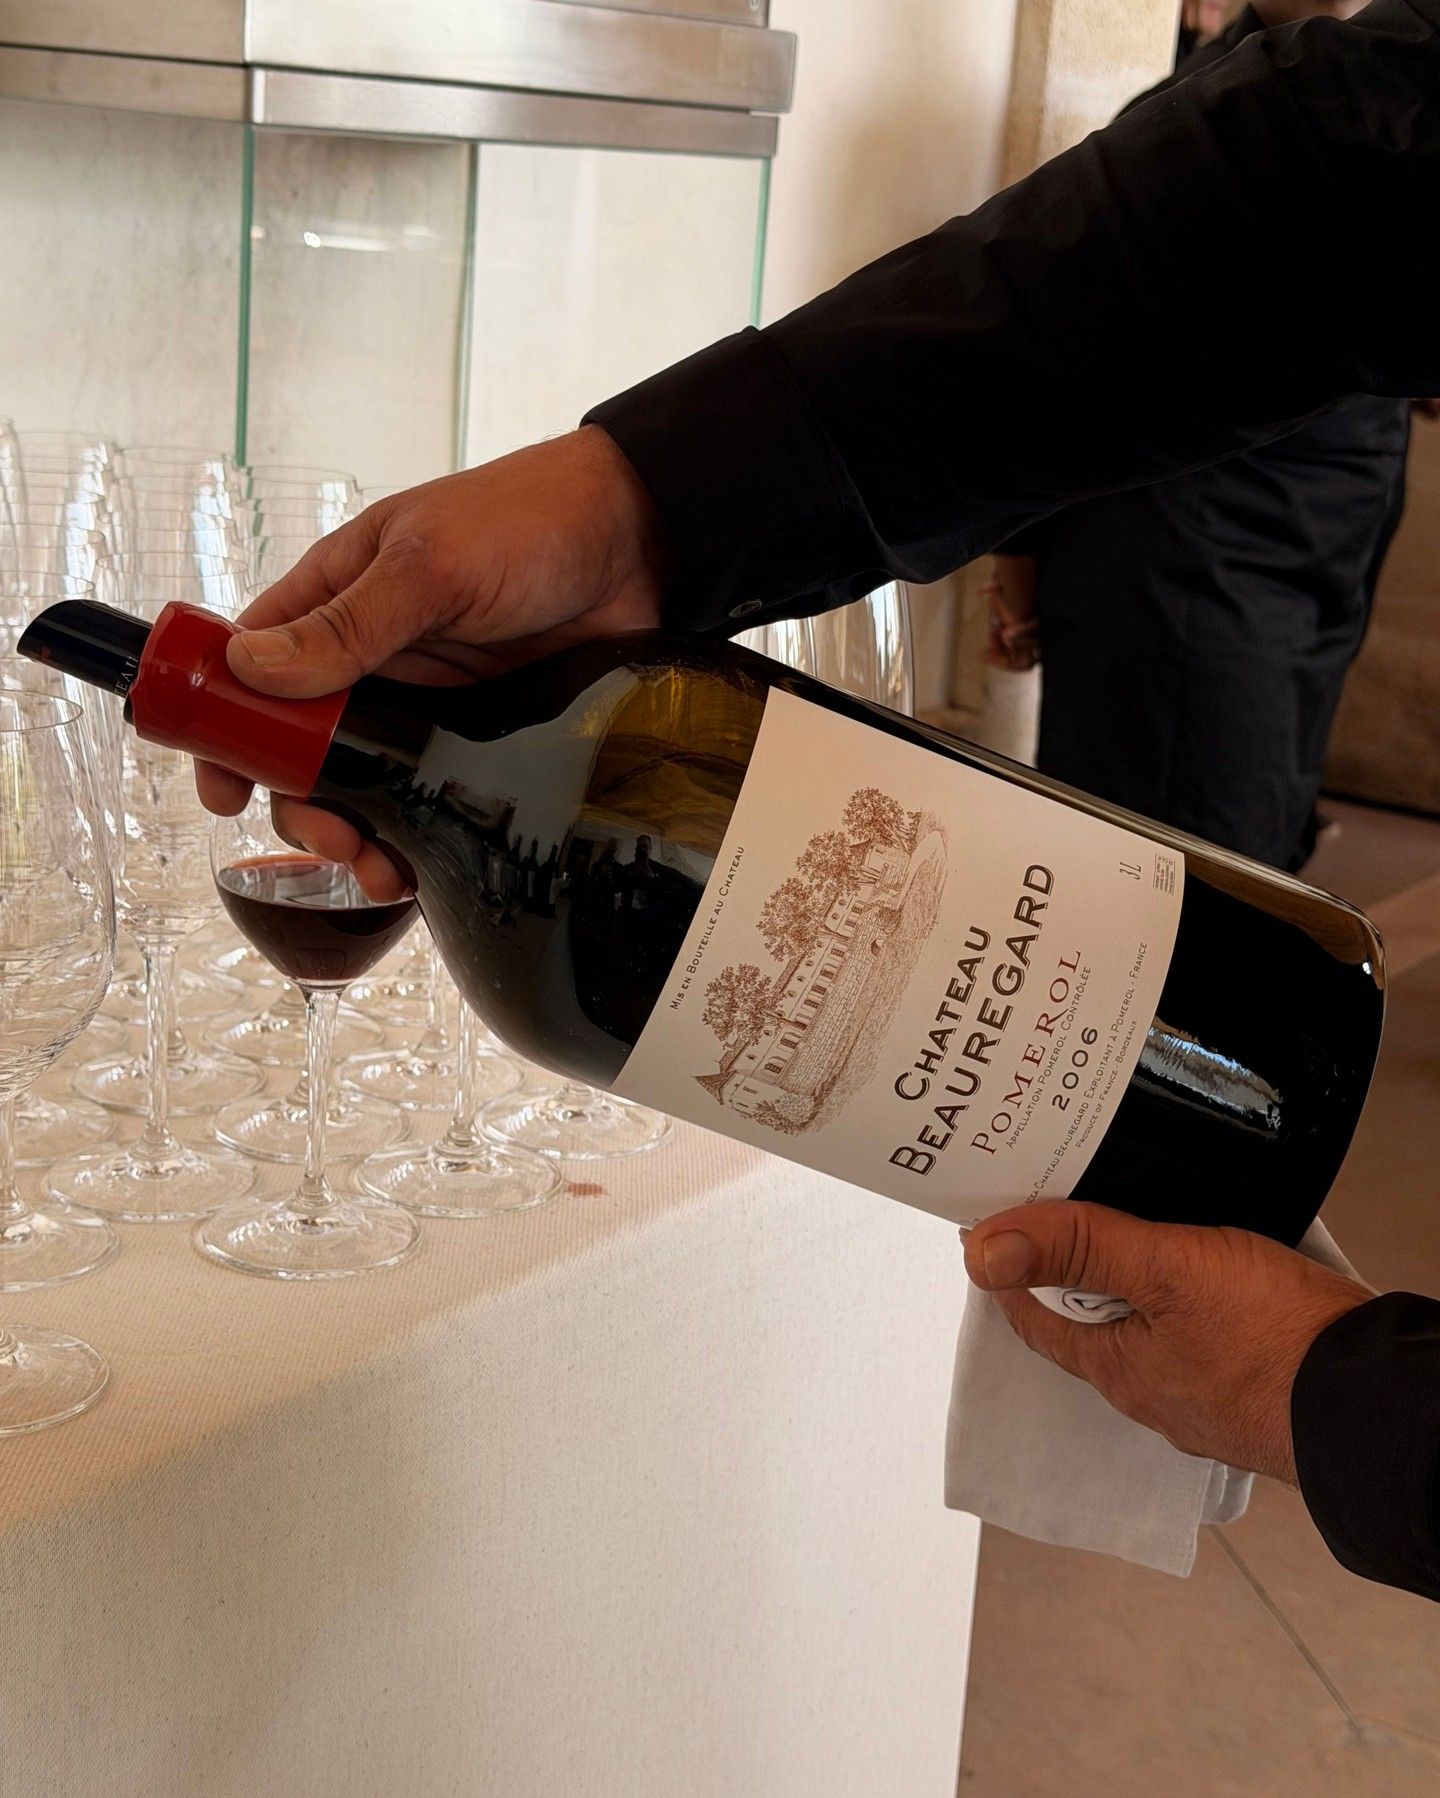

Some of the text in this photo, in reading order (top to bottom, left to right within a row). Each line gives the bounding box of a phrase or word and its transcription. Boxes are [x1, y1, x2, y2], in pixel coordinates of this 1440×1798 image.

[713, 900, 724, 916] AU
[719, 846, 745, 897] CHATEAU
[681, 977, 692, 991] EN
[686, 917, 717, 974] BOUTEILLE
[888, 864, 1056, 1178] BEAUREGARD
[894, 925, 992, 1102] CHATEAU
[970, 950, 1082, 1156] POMEROL
[1006, 966, 1091, 1149] APPELLATION POMEROL CONTRÔLÉE
[1034, 1158, 1060, 1190] CHATEAU
[1053, 1102, 1089, 1157] BEAUREGARD
[1083, 1043, 1114, 1100] EXPLOITANT
[1111, 988, 1135, 1033] POMEROL
[1129, 942, 1148, 979] FRANCE
[1051, 1026, 1098, 1112] 2006
[1099, 1069, 1118, 1102] FRANCE
[1115, 1020, 1137, 1064] BORDEAUX
